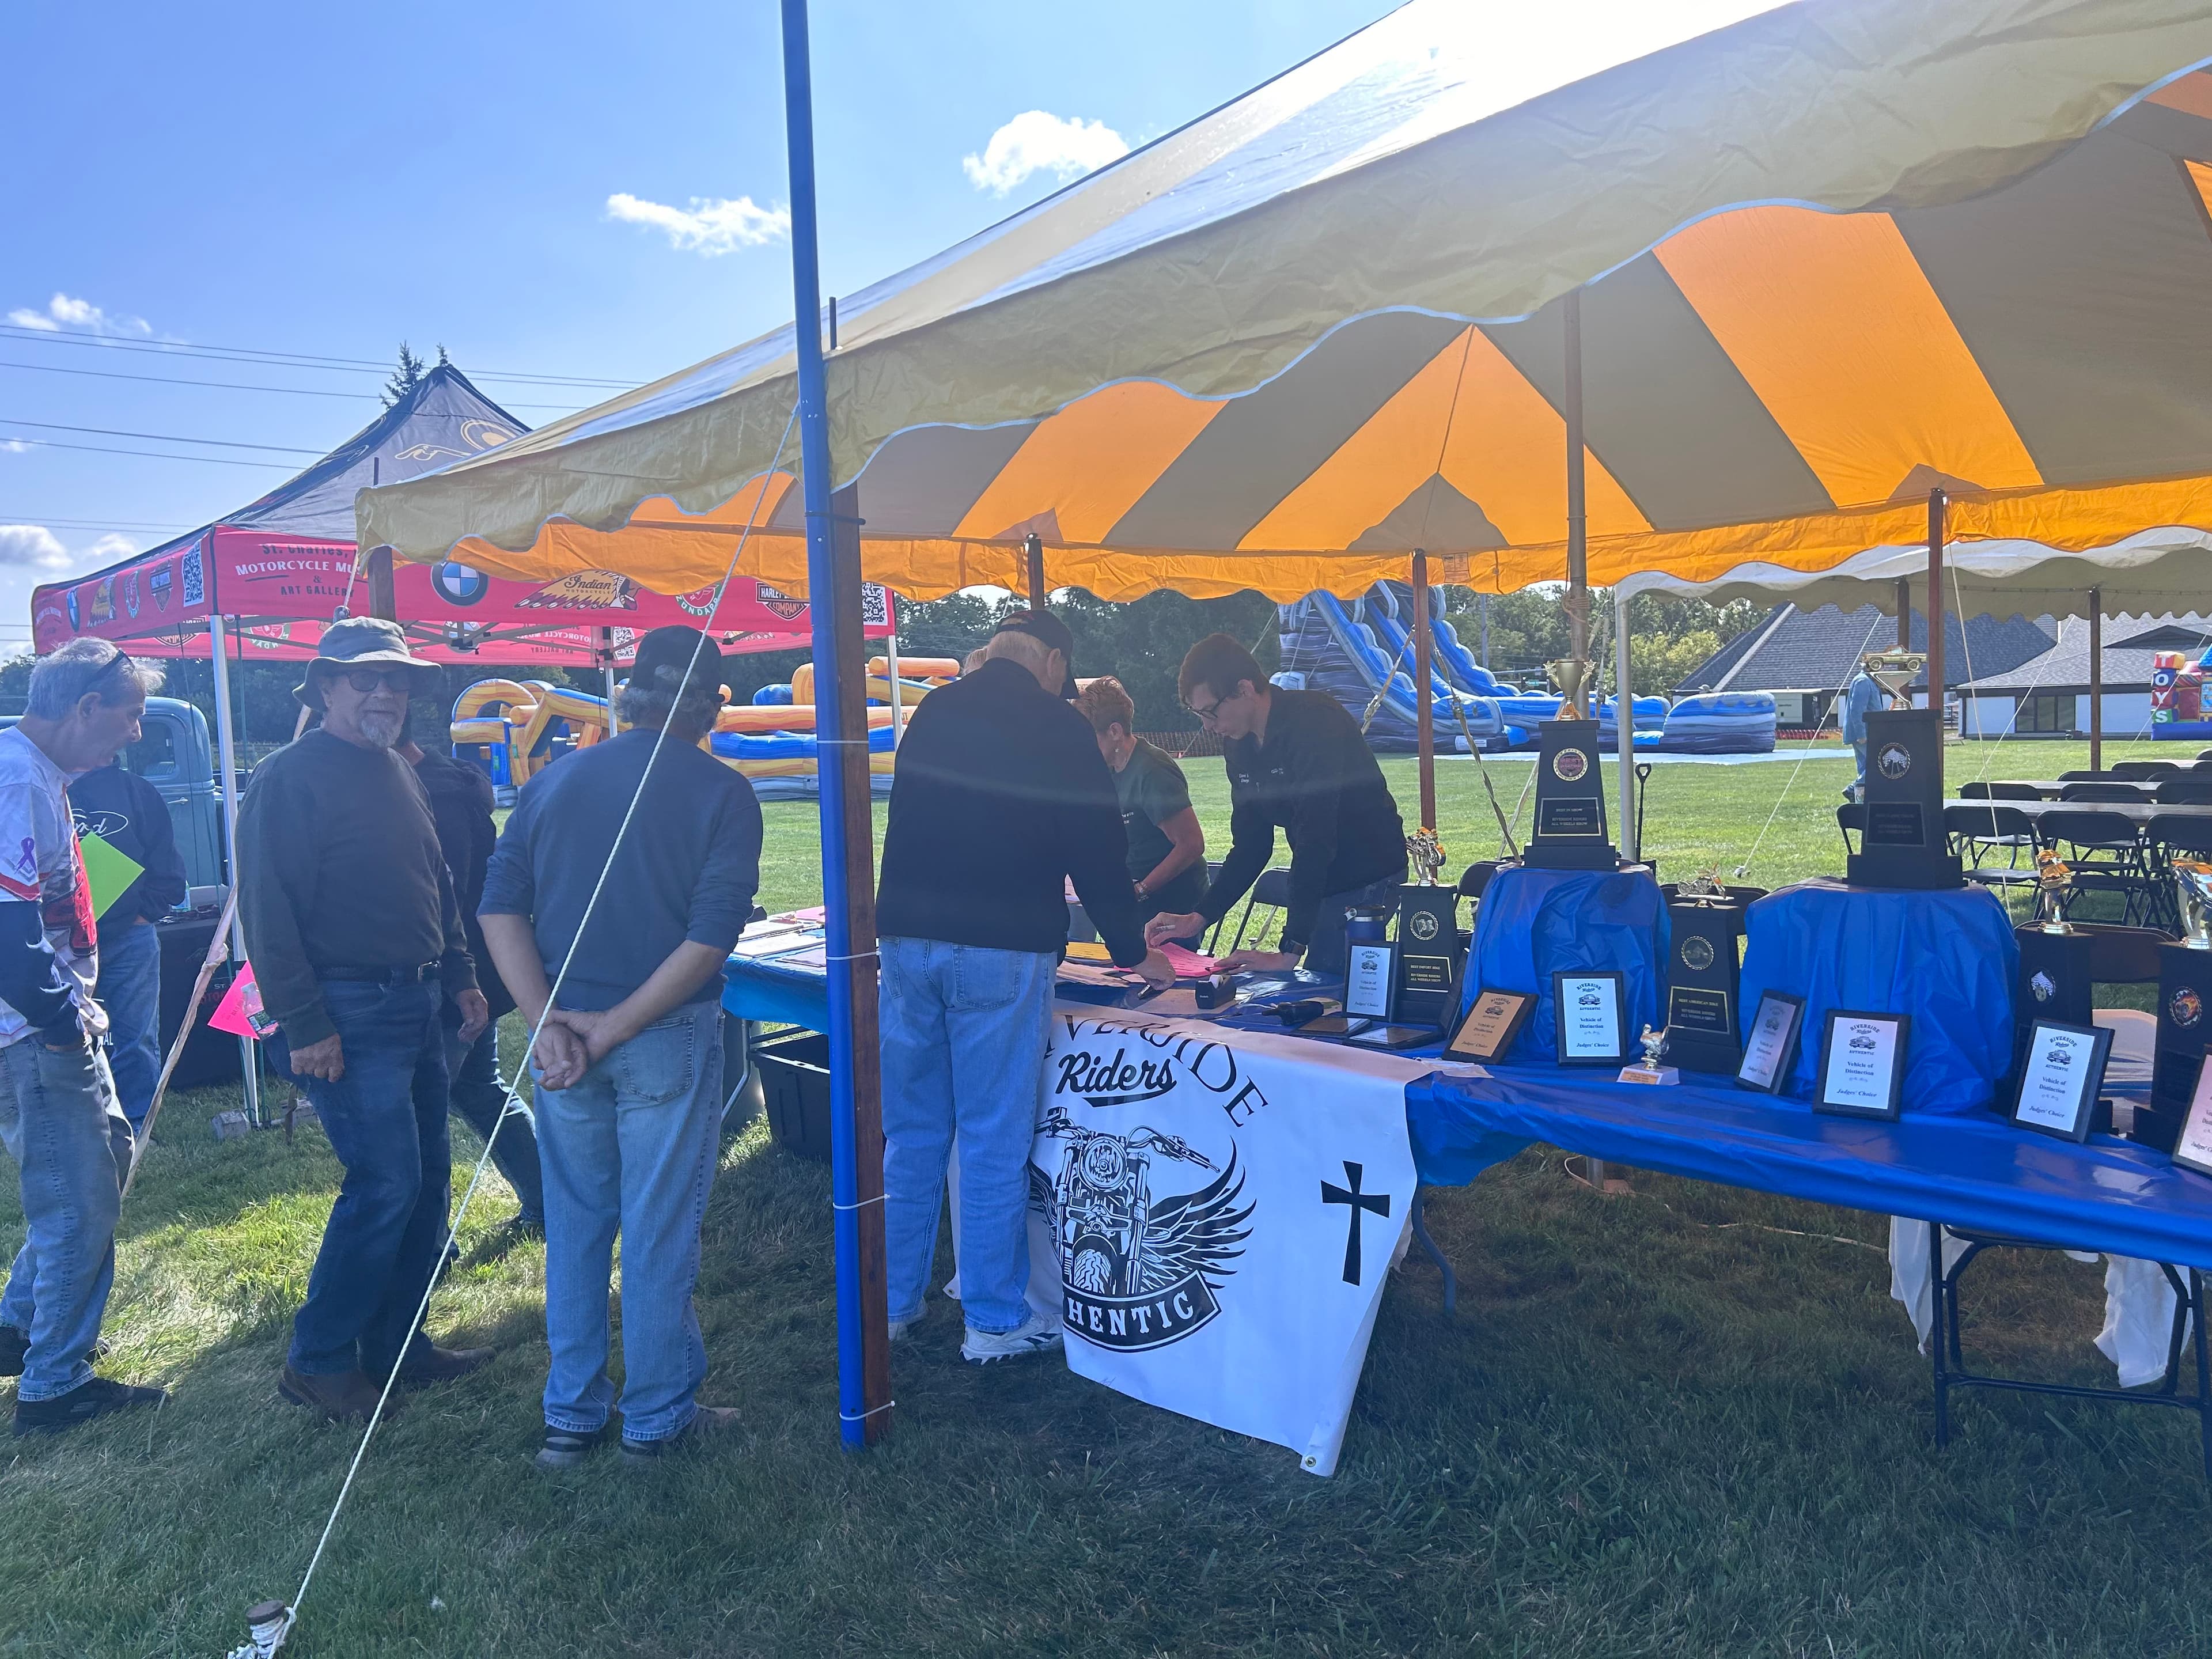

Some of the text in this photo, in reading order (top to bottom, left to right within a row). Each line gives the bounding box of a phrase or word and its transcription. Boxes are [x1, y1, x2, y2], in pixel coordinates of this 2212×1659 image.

[235, 560, 329, 575] MOTORCYCLE
[564, 575, 611, 590] Indian
[281, 586, 354, 597] ART GALLERY
[773, 602, 801, 616] COMPANY
[1850, 1024, 1880, 1033] RIVERSIDE
[2050, 1036, 2077, 1047] RIVERSIDE
[1055, 1048, 1177, 1097] Riders
[2043, 1076, 2059, 1085] Vehicle
[2039, 1084, 2066, 1094] Distinction
[2029, 1105, 2065, 1118] Judges' Choice
[1067, 1290, 1194, 1336] HENTIC
